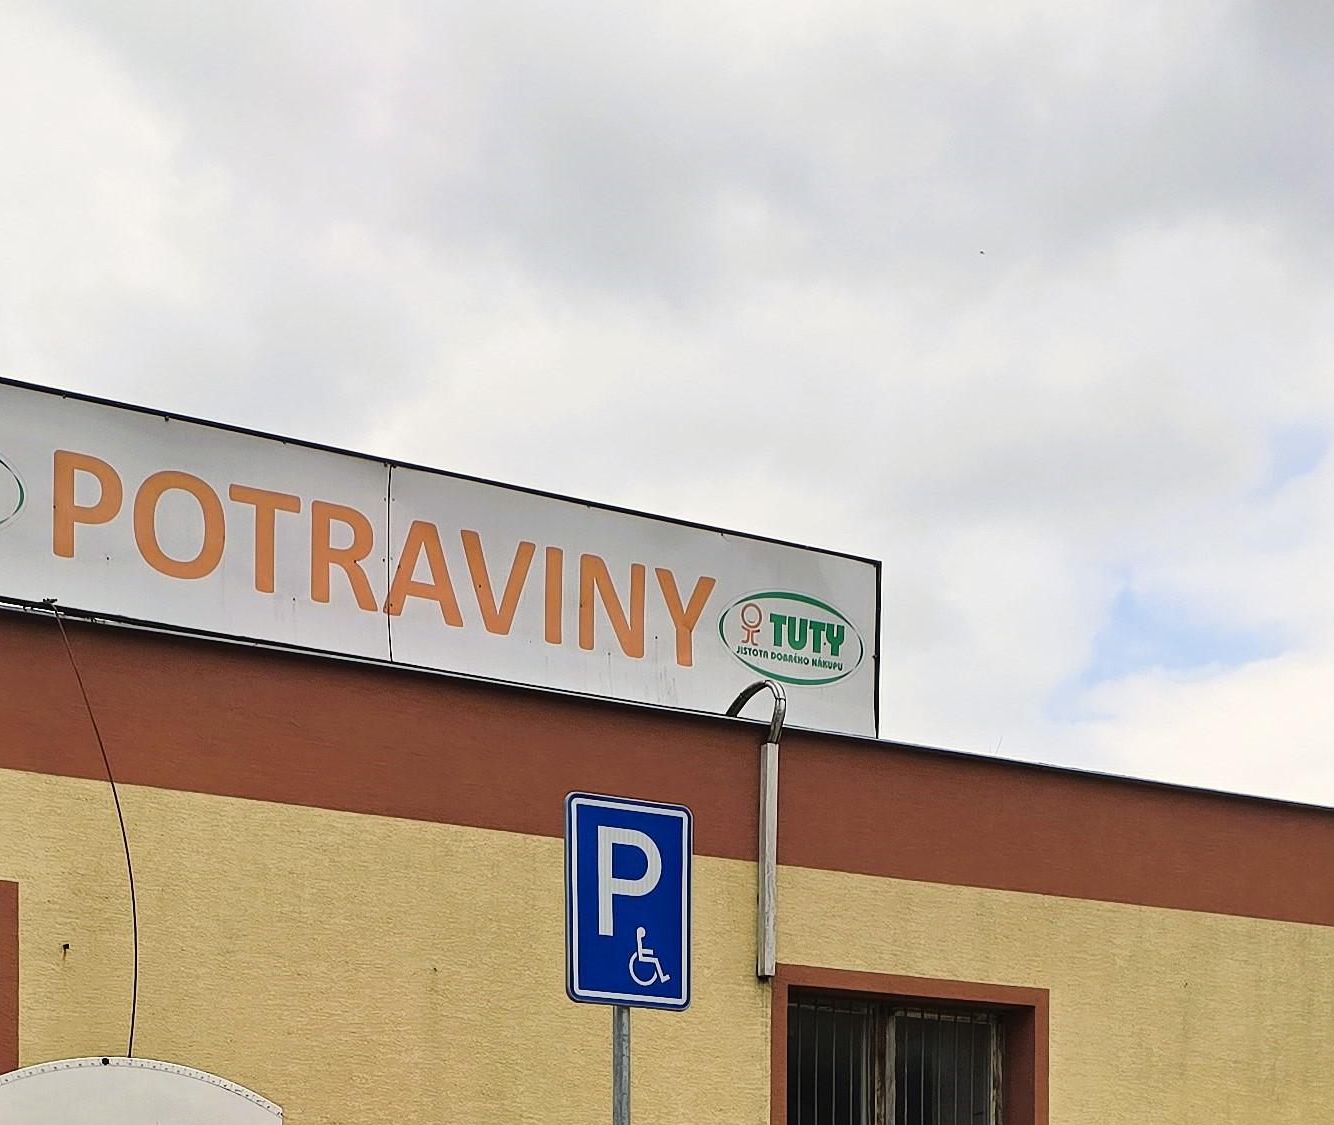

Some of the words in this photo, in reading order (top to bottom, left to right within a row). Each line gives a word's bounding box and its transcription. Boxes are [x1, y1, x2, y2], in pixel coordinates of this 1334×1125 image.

[52, 449, 716, 667] POTRAVINY
[736, 645, 768, 659] JISTOTA
[770, 652, 810, 666] DOBRÉHO
[811, 657, 843, 671] NÁKUPU
[769, 612, 845, 657] TUTY
[597, 825, 662, 936] P
